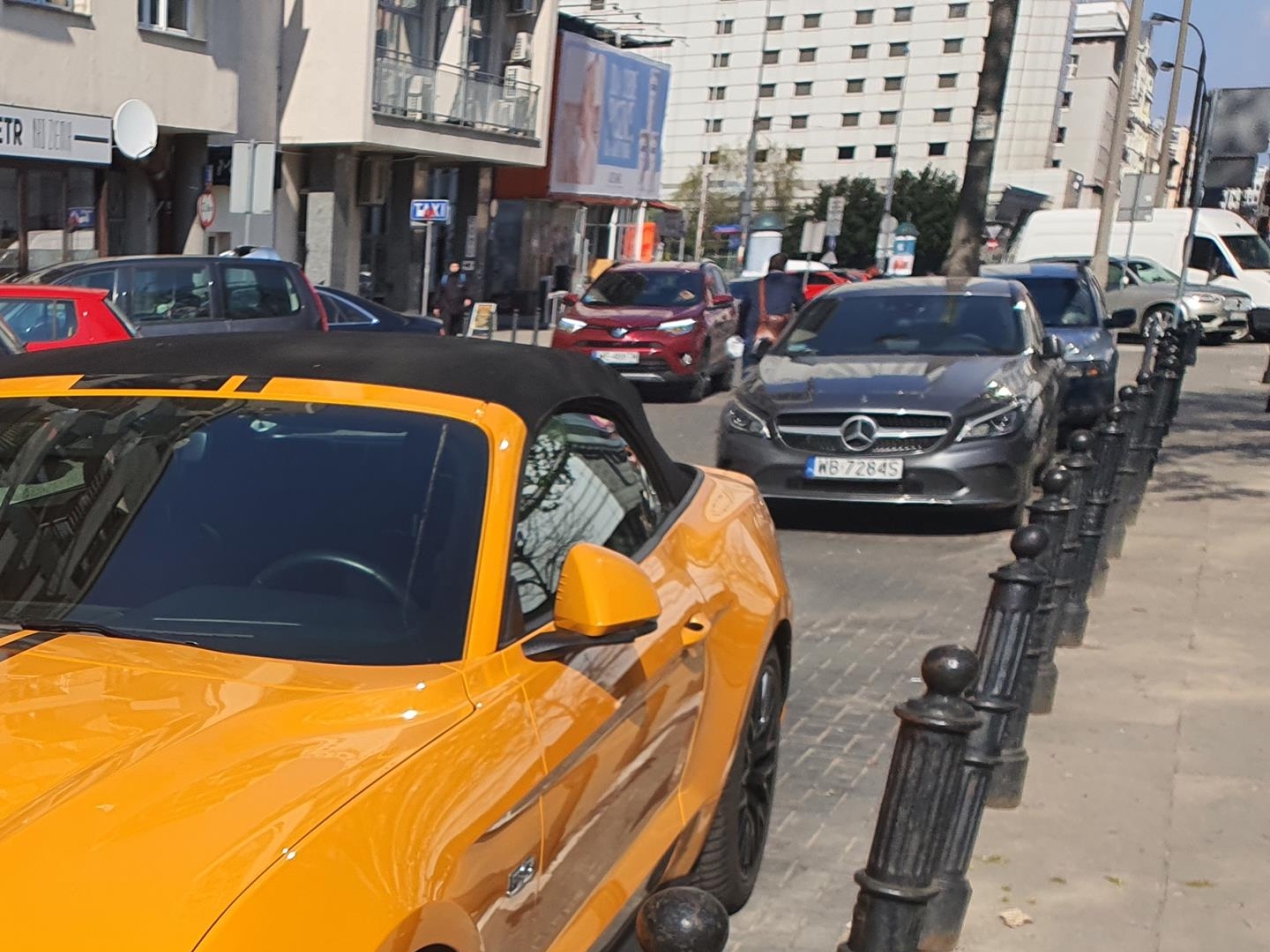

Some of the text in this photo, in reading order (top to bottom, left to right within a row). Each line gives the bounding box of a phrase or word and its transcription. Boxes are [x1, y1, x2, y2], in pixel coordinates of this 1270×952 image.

[413, 202, 447, 217] TAXI
[818, 460, 899, 477] WB 7284S
